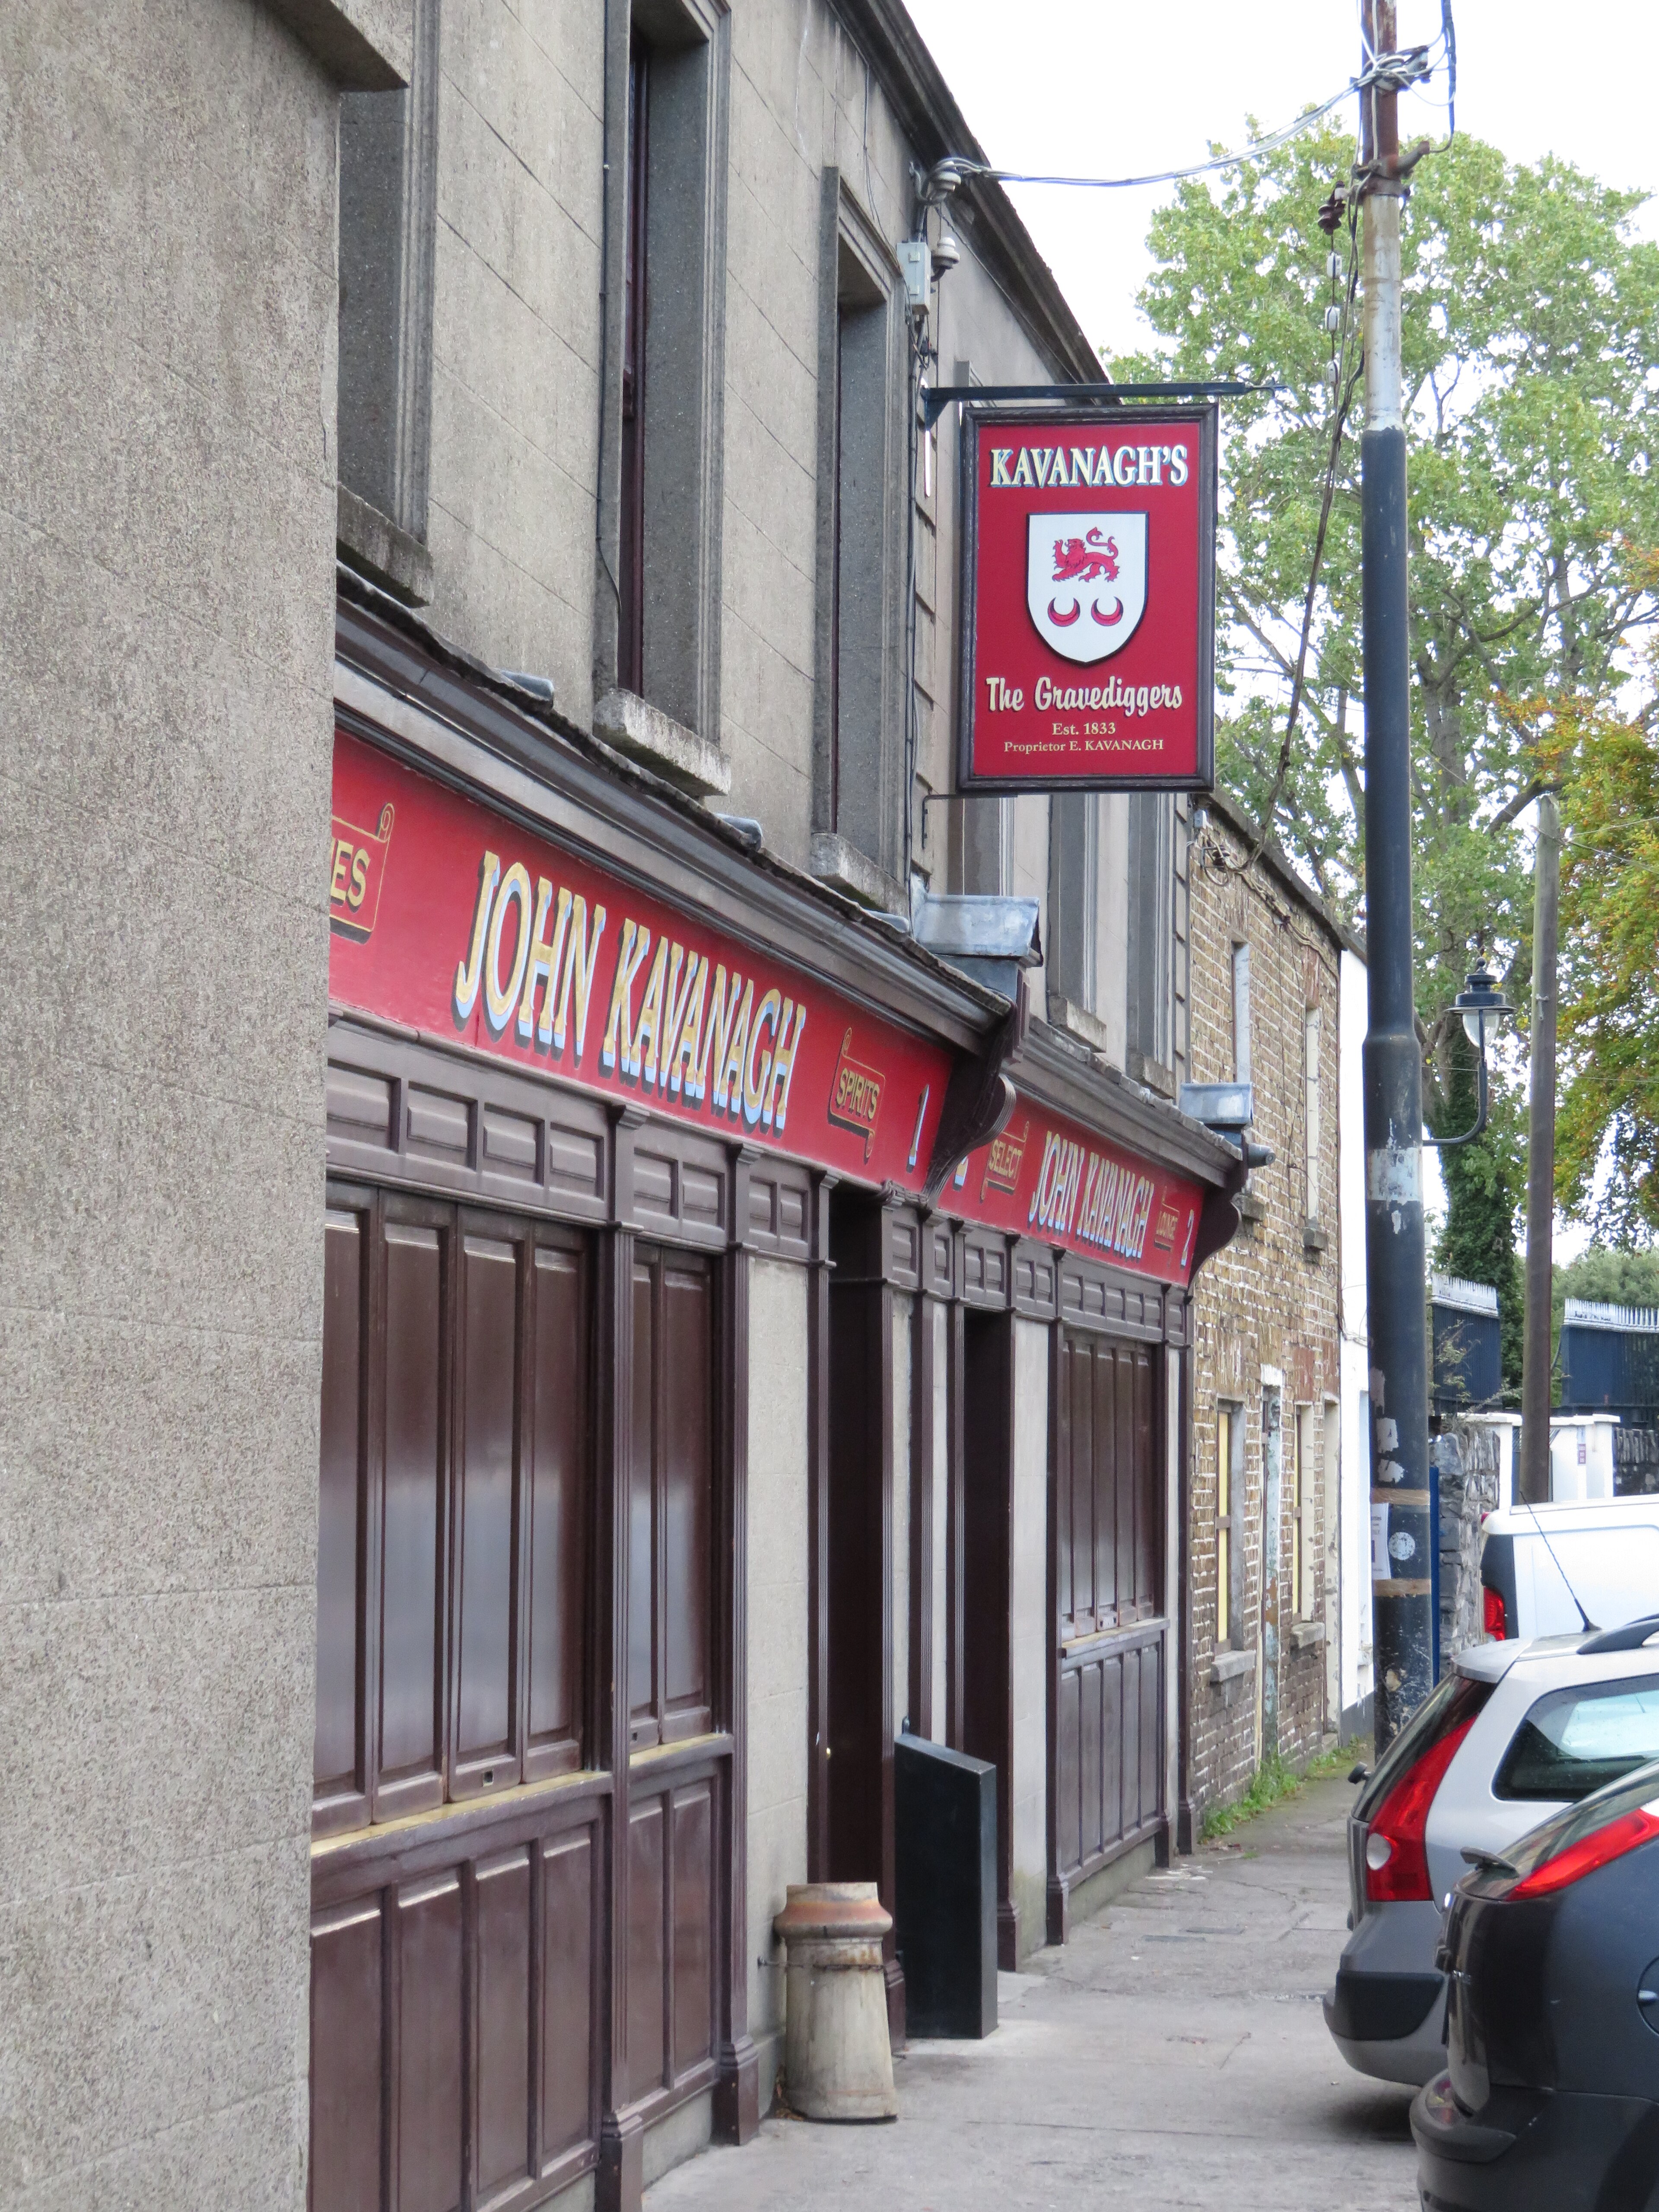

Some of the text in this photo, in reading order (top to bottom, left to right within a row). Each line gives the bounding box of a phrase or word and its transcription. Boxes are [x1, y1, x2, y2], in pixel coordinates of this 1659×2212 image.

[989, 444, 1189, 489] KAVANAGH'S
[986, 675, 1183, 718] The Gravediggers
[1003, 739, 1164, 755] Proprietor E. KAVANAGH
[1052, 721, 1116, 736] Est. 1833
[454, 850, 806, 1138] JOHN KAVANAGH
[835, 1067, 880, 1122] SPIRITS
[988, 1139, 1023, 1179] SELECT
[1027, 1130, 1155, 1262] JOHN KAVANAGH
